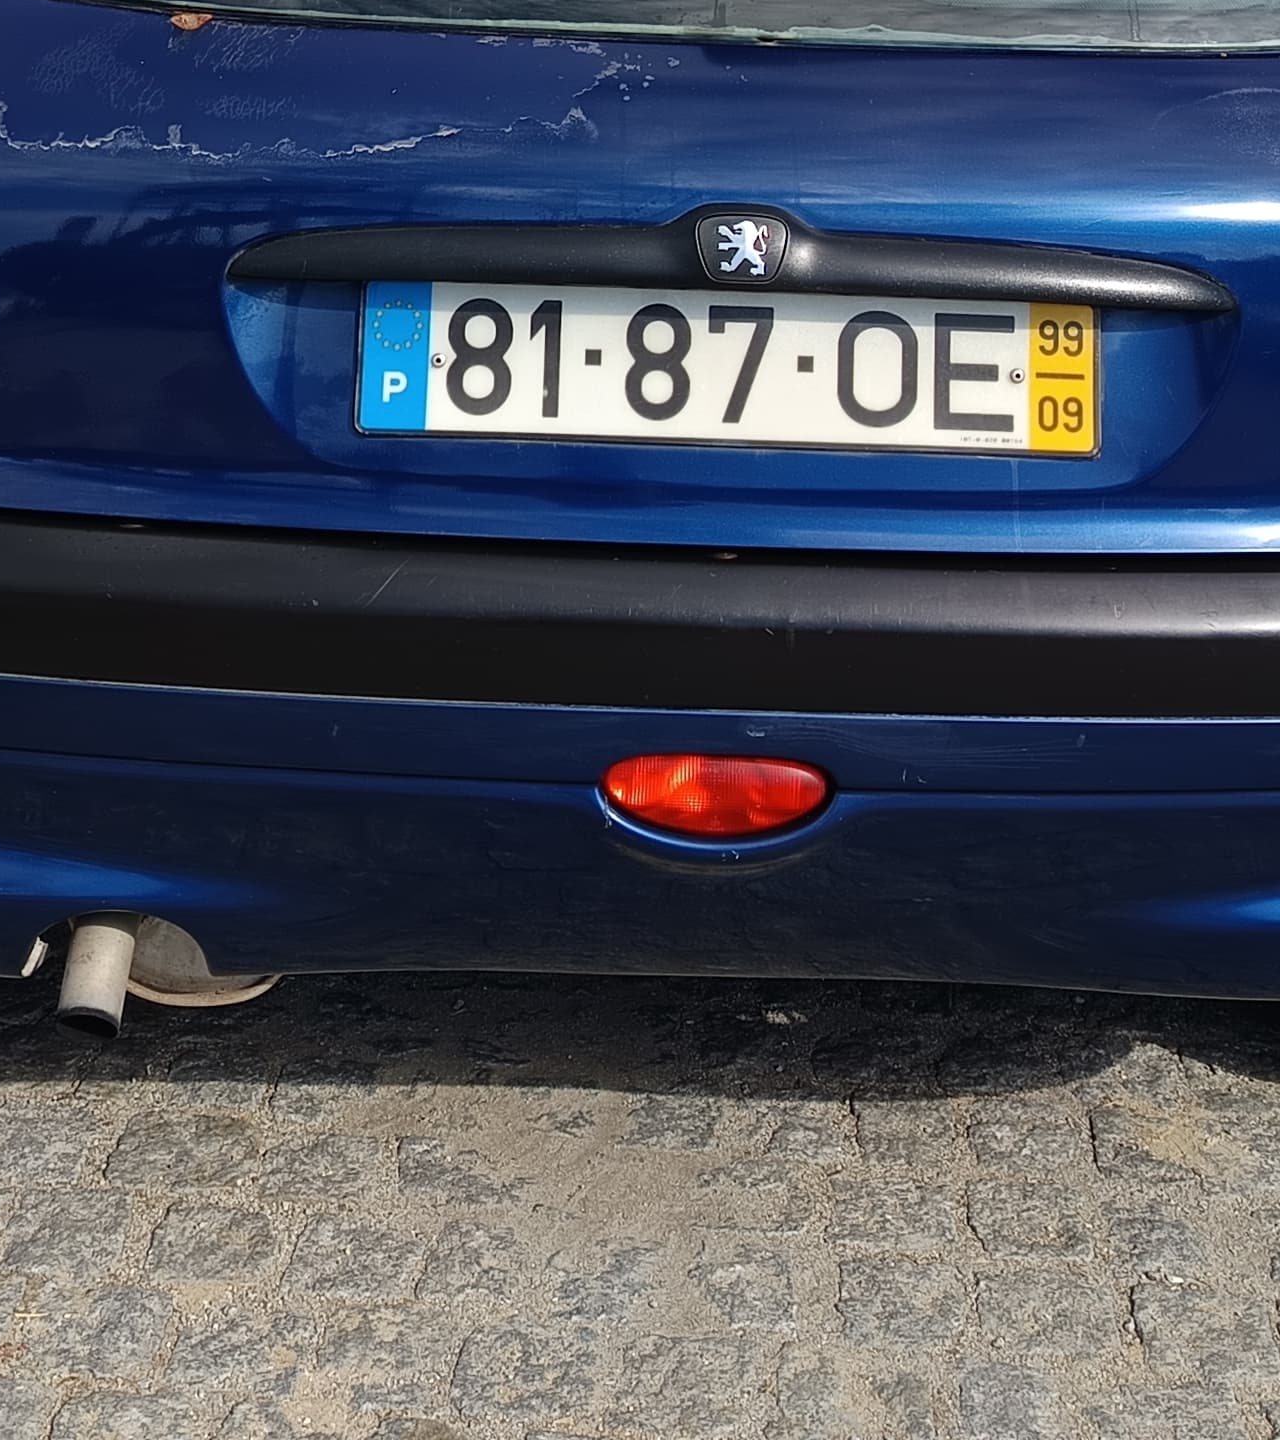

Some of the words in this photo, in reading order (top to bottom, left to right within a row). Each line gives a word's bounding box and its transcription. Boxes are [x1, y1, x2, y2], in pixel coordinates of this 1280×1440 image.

[1038, 319, 1083, 356] 99
[382, 371, 408, 403] P
[1038, 395, 1083, 433] 09
